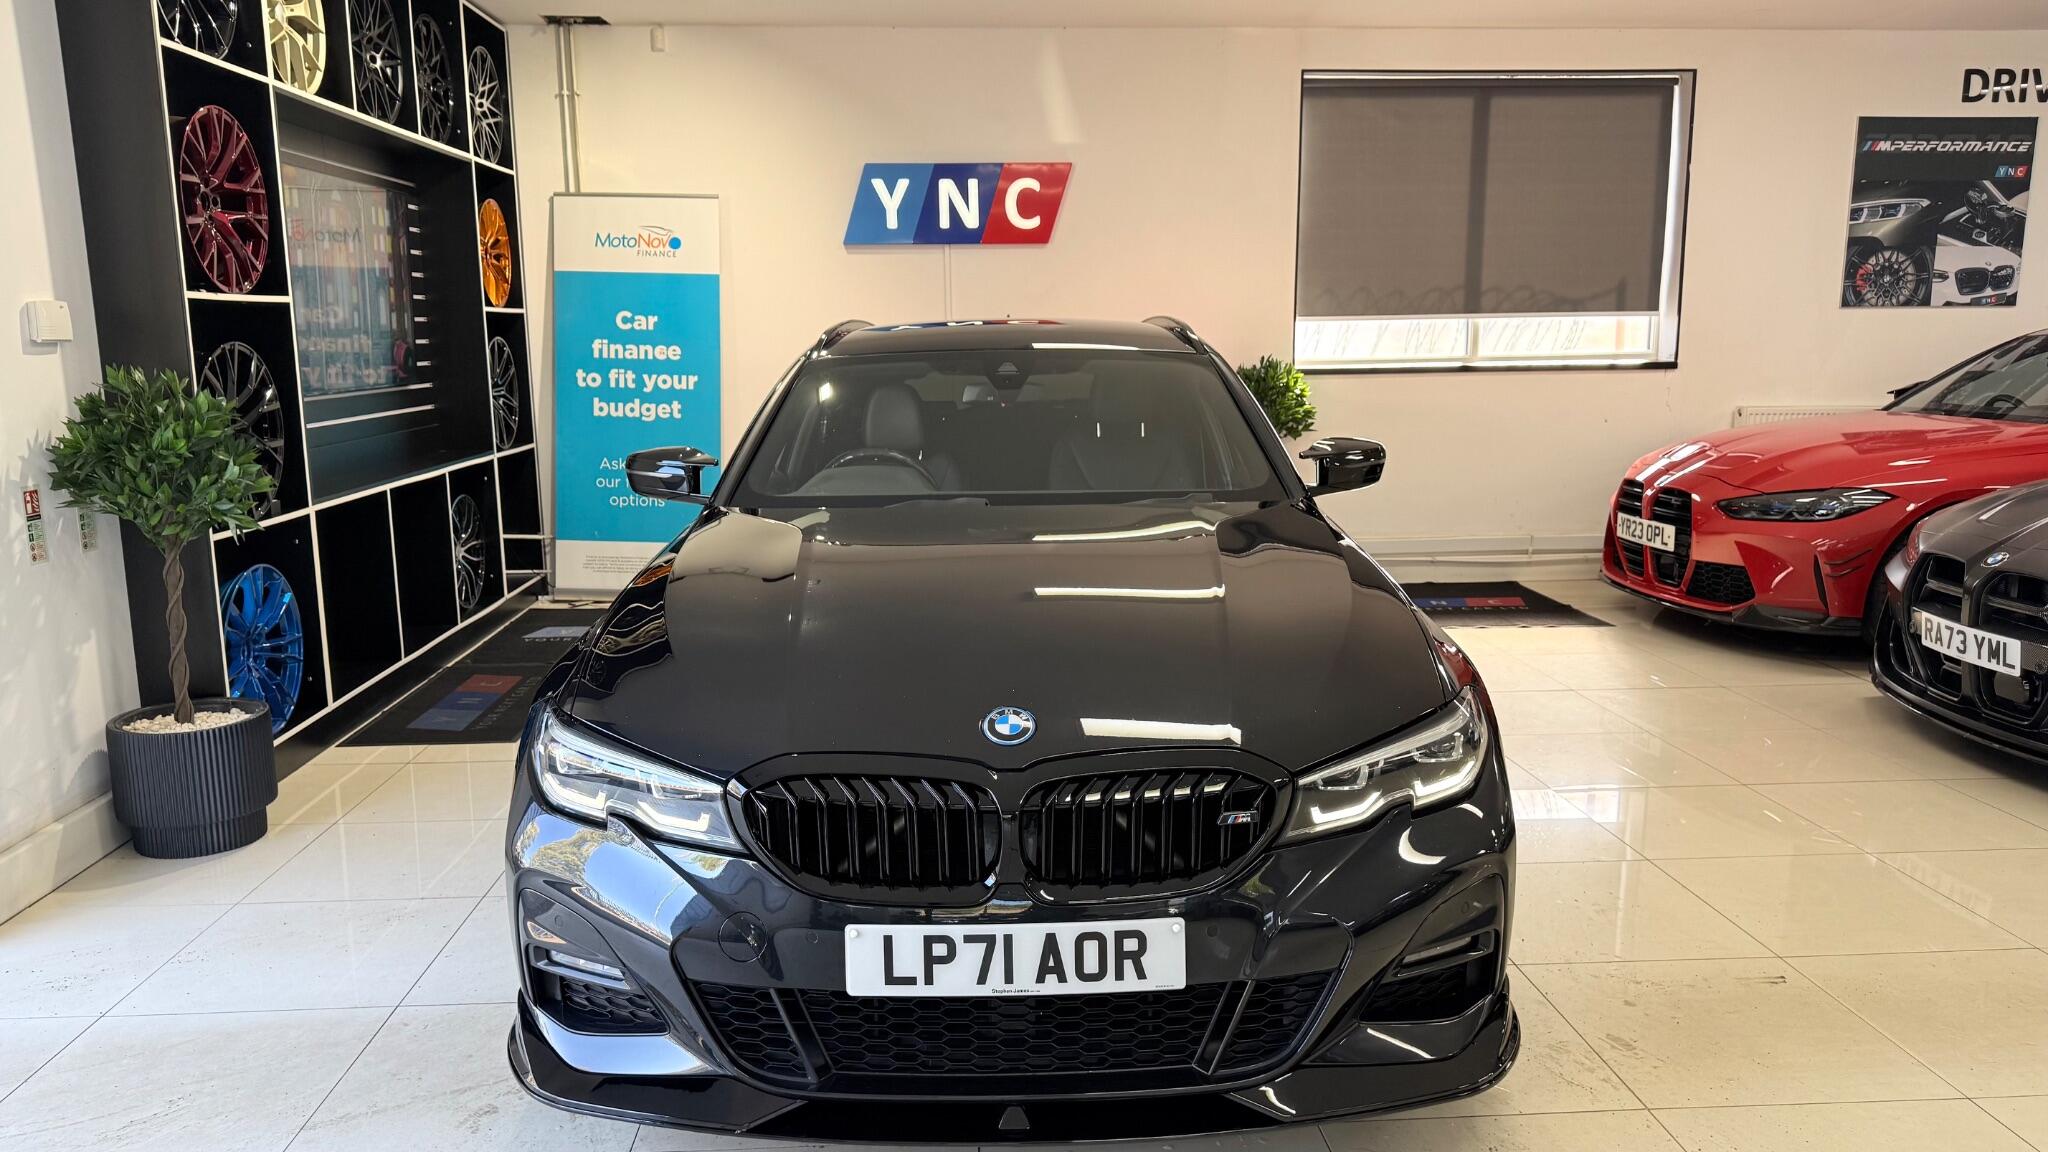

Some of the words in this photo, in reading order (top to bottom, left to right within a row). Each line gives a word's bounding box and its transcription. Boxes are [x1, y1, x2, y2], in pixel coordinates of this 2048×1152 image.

[1999, 167, 2024, 176] YNC
[870, 177, 1041, 230] YNC
[636, 250, 677, 258] FINANCE
[615, 310, 658, 331] Car
[592, 338, 682, 360] finance
[575, 368, 602, 388] to
[608, 368, 636, 389] fit
[642, 373, 698, 393] your
[593, 397, 682, 421] budget
[600, 457, 626, 470] Ask
[596, 477, 621, 488] our
[609, 494, 665, 508] options
[1620, 516, 1644, 540] YR23
[1646, 524, 1669, 547] OPL
[1924, 616, 1967, 655] RA73
[1973, 633, 2016, 670] YML
[882, 933, 1014, 986] LP71
[1035, 929, 1148, 985] AOR
